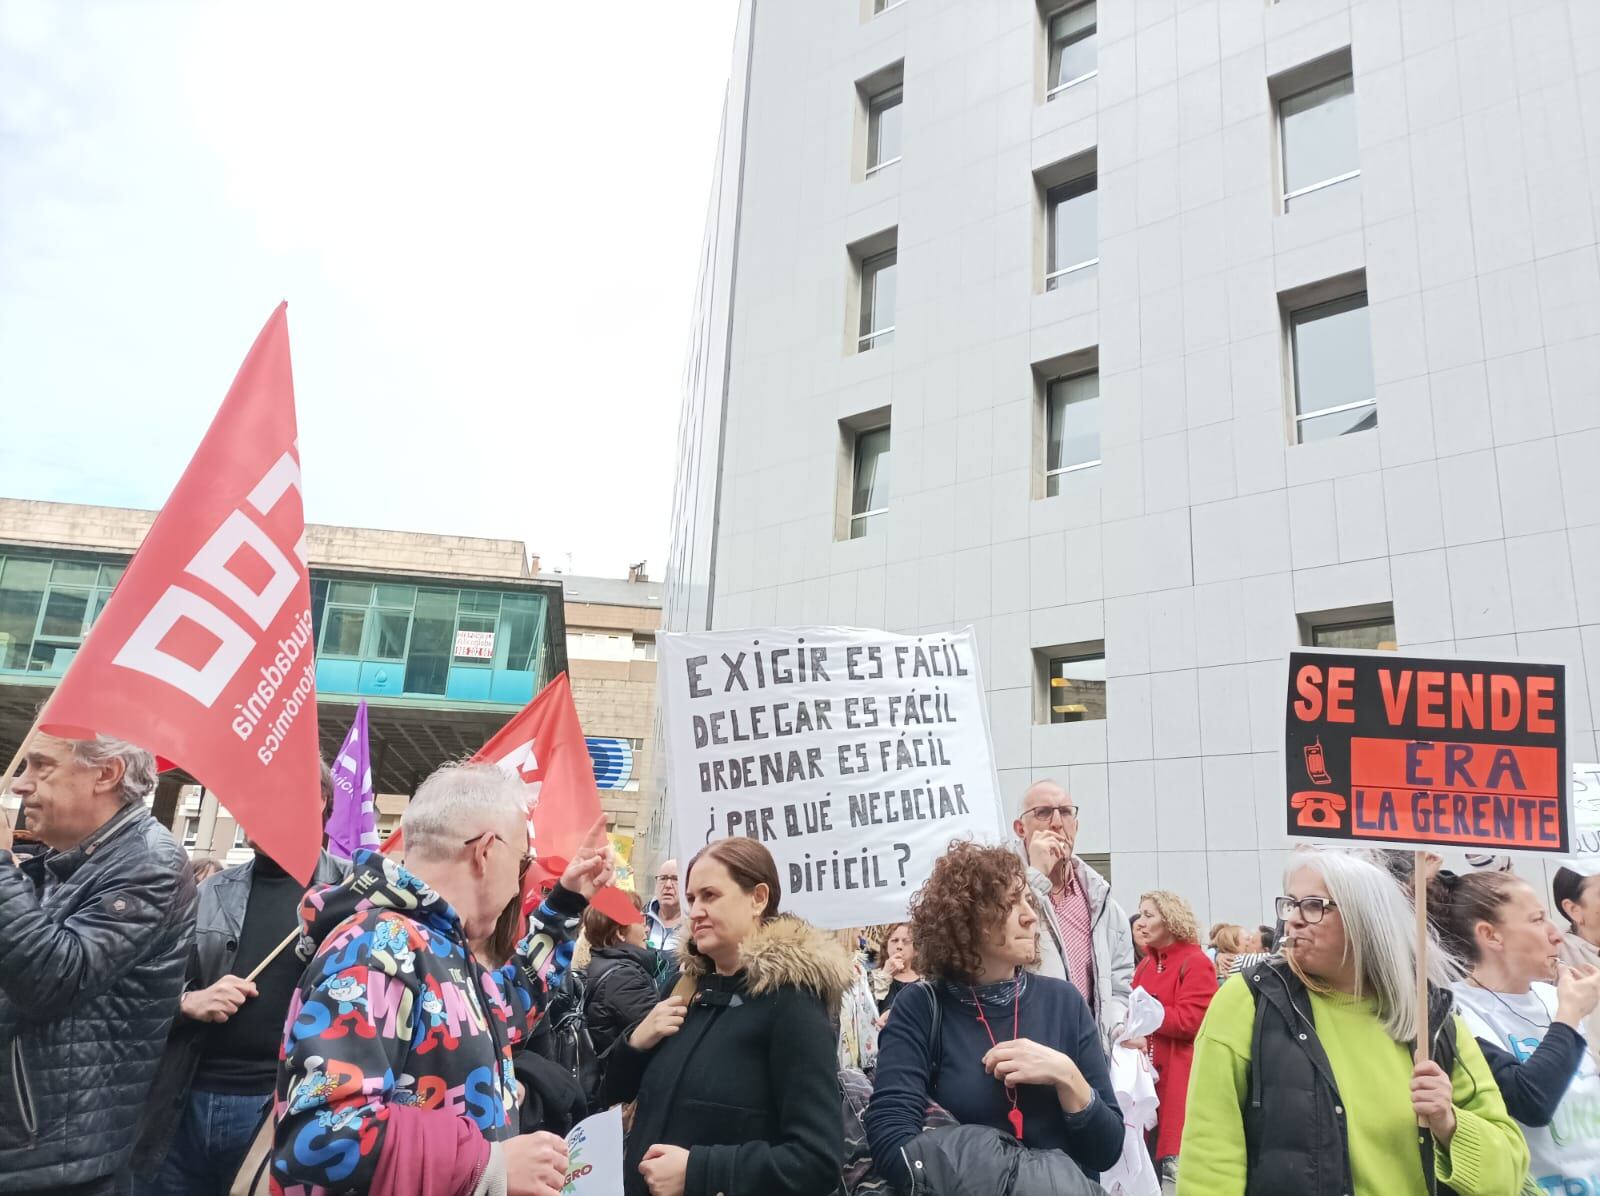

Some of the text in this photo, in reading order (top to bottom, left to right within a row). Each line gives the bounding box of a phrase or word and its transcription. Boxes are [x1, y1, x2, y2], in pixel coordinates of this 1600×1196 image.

[686, 637, 968, 699] EXIGIR ES FÁCIL
[692, 685, 957, 749] DELEGAR ES FÁCIL
[1293, 664, 1556, 733] SE VENDE
[699, 730, 951, 792] ORDENAR ES FÁCIL
[1405, 742, 1527, 791] ERA
[784, 792, 833, 837] QUÉ
[848, 779, 971, 827] NEGOCIAR
[1355, 790, 1399, 831] LA
[1411, 791, 1558, 842] GERENTE
[349, 870, 380, 896] THE
